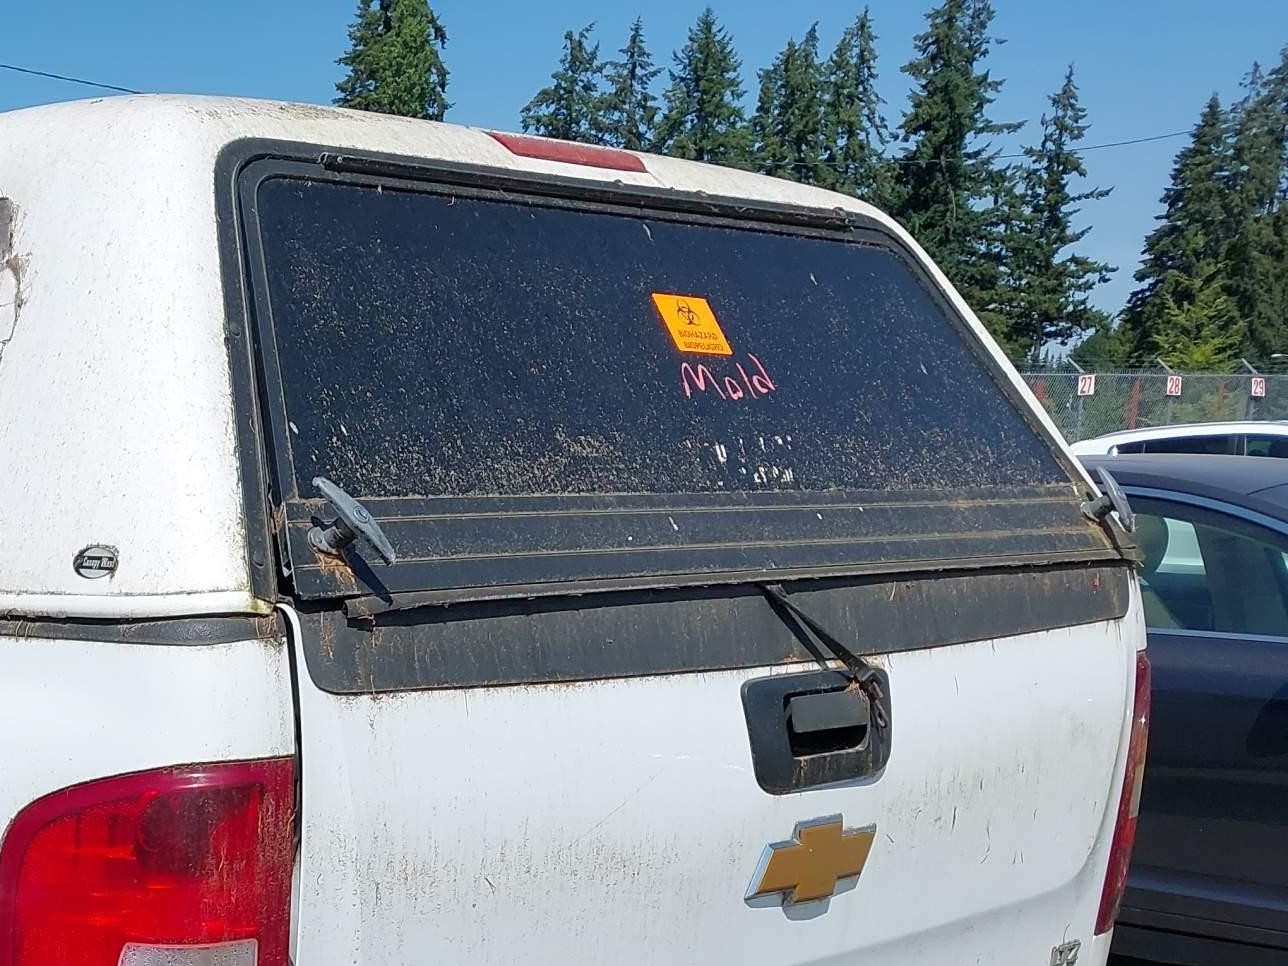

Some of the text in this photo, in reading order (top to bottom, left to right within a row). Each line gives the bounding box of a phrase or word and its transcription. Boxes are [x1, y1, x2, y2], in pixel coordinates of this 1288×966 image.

[677, 329, 718, 340] BIOHAZARD
[681, 353, 776, 401] Mold
[1080, 377, 1093, 394] 27
[1168, 377, 1180, 394] 28
[1253, 378, 1265, 395] 29
